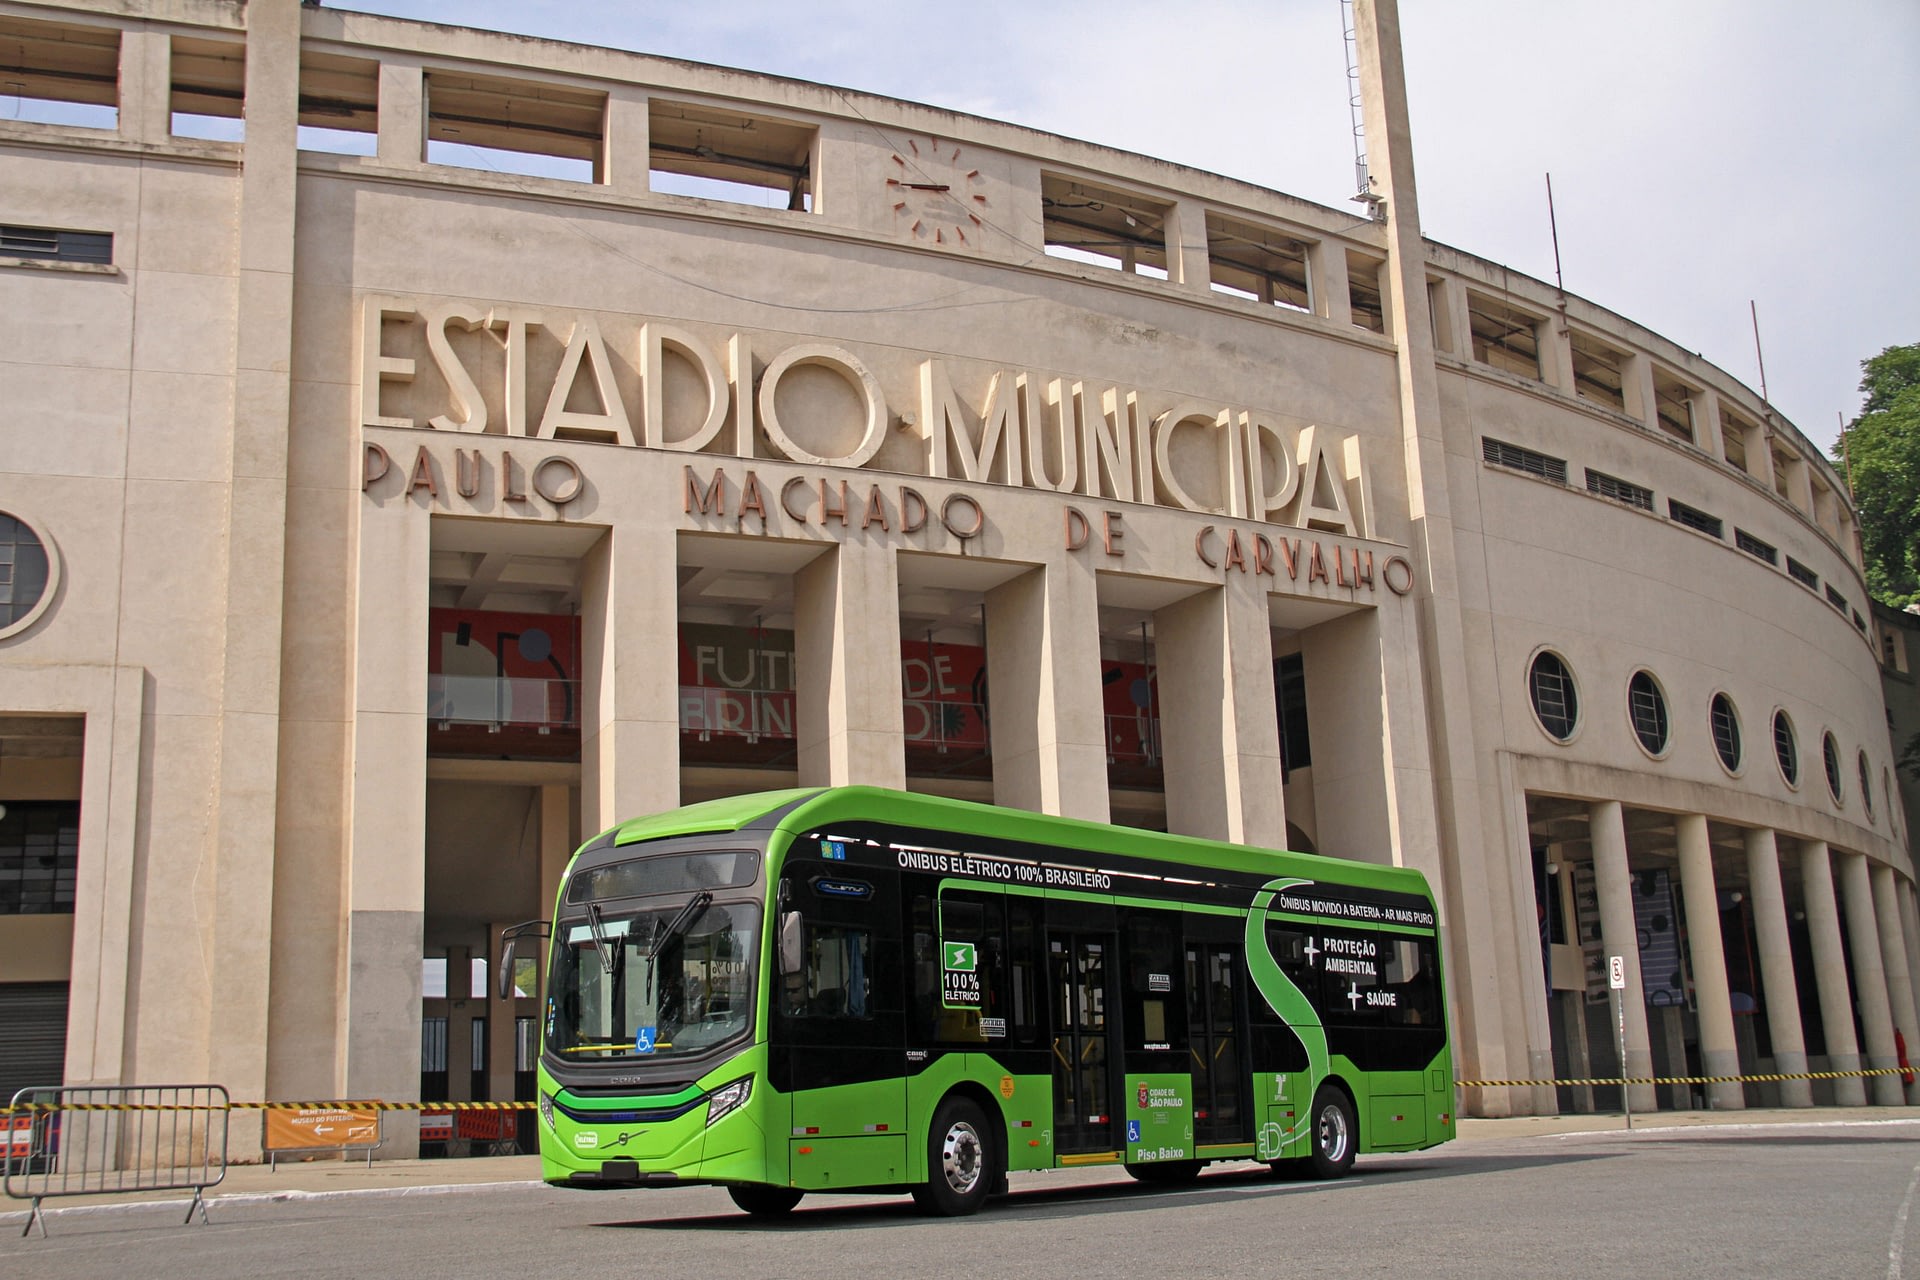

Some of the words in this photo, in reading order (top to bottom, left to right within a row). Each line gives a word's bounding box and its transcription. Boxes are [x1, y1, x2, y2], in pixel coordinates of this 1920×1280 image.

[363, 298, 889, 468] ESTADIO
[920, 358, 1391, 542] MUNICIPAL
[362, 440, 584, 504] PAULO
[684, 464, 985, 539] MACHADO
[1064, 505, 1125, 557] DE
[1195, 525, 1414, 596] CARVALHO
[897, 847, 948, 871] ÔNIBUS
[951, 855, 1012, 879] ELÉTRICO
[1014, 864, 1044, 883] 100%
[1046, 868, 1111, 889] BRASILEIRO
[1280, 893, 1311, 911] ÔNIBUS
[1311, 900, 1342, 915] MOVIDO
[1343, 904, 1349, 916] A
[1349, 904, 1380, 919] BATERIA
[1385, 908, 1396, 920] AR
[1396, 909, 1413, 922] MAIS
[1414, 912, 1433, 925] PURO
[1323, 937, 1376, 958] PROTEÇÃO
[1325, 957, 1377, 975] AMBIENTAL
[944, 972, 980, 990] 100%
[944, 988, 980, 1001] ELÉTRICO
[1366, 989, 1396, 1006] SAÚDE
[1149, 1088, 1167, 1097] CIDADE
[1168, 1088, 1175, 1097] DE
[1149, 1096, 1163, 1107] SÃO
[1163, 1097, 1183, 1107] PAULO
[1137, 1148, 1157, 1160] Piso
[1159, 1146, 1184, 1159] Baixo
